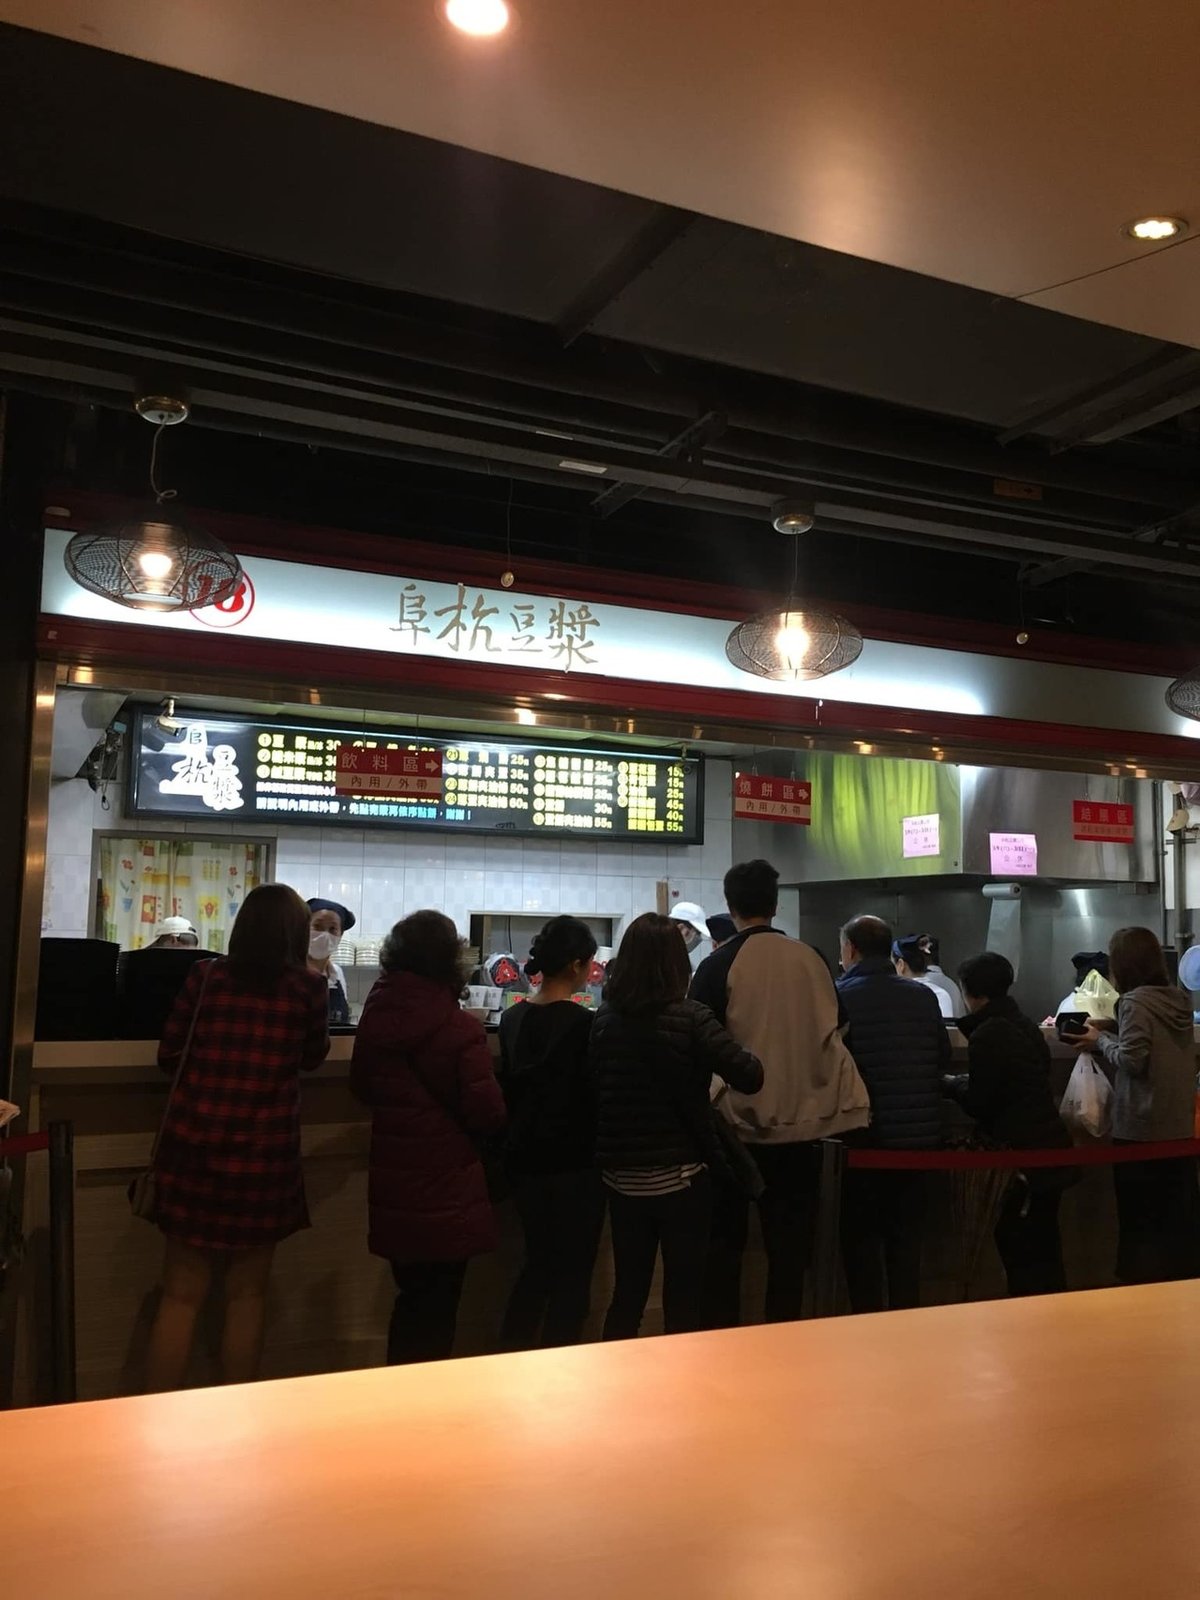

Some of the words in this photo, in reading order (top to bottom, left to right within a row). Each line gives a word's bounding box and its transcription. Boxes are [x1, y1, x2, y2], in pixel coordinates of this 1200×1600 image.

[390, 582, 600, 672] 阜杭豆漿
[342, 752, 419, 772] 飲料區
[739, 780, 794, 799] 燒餅區
